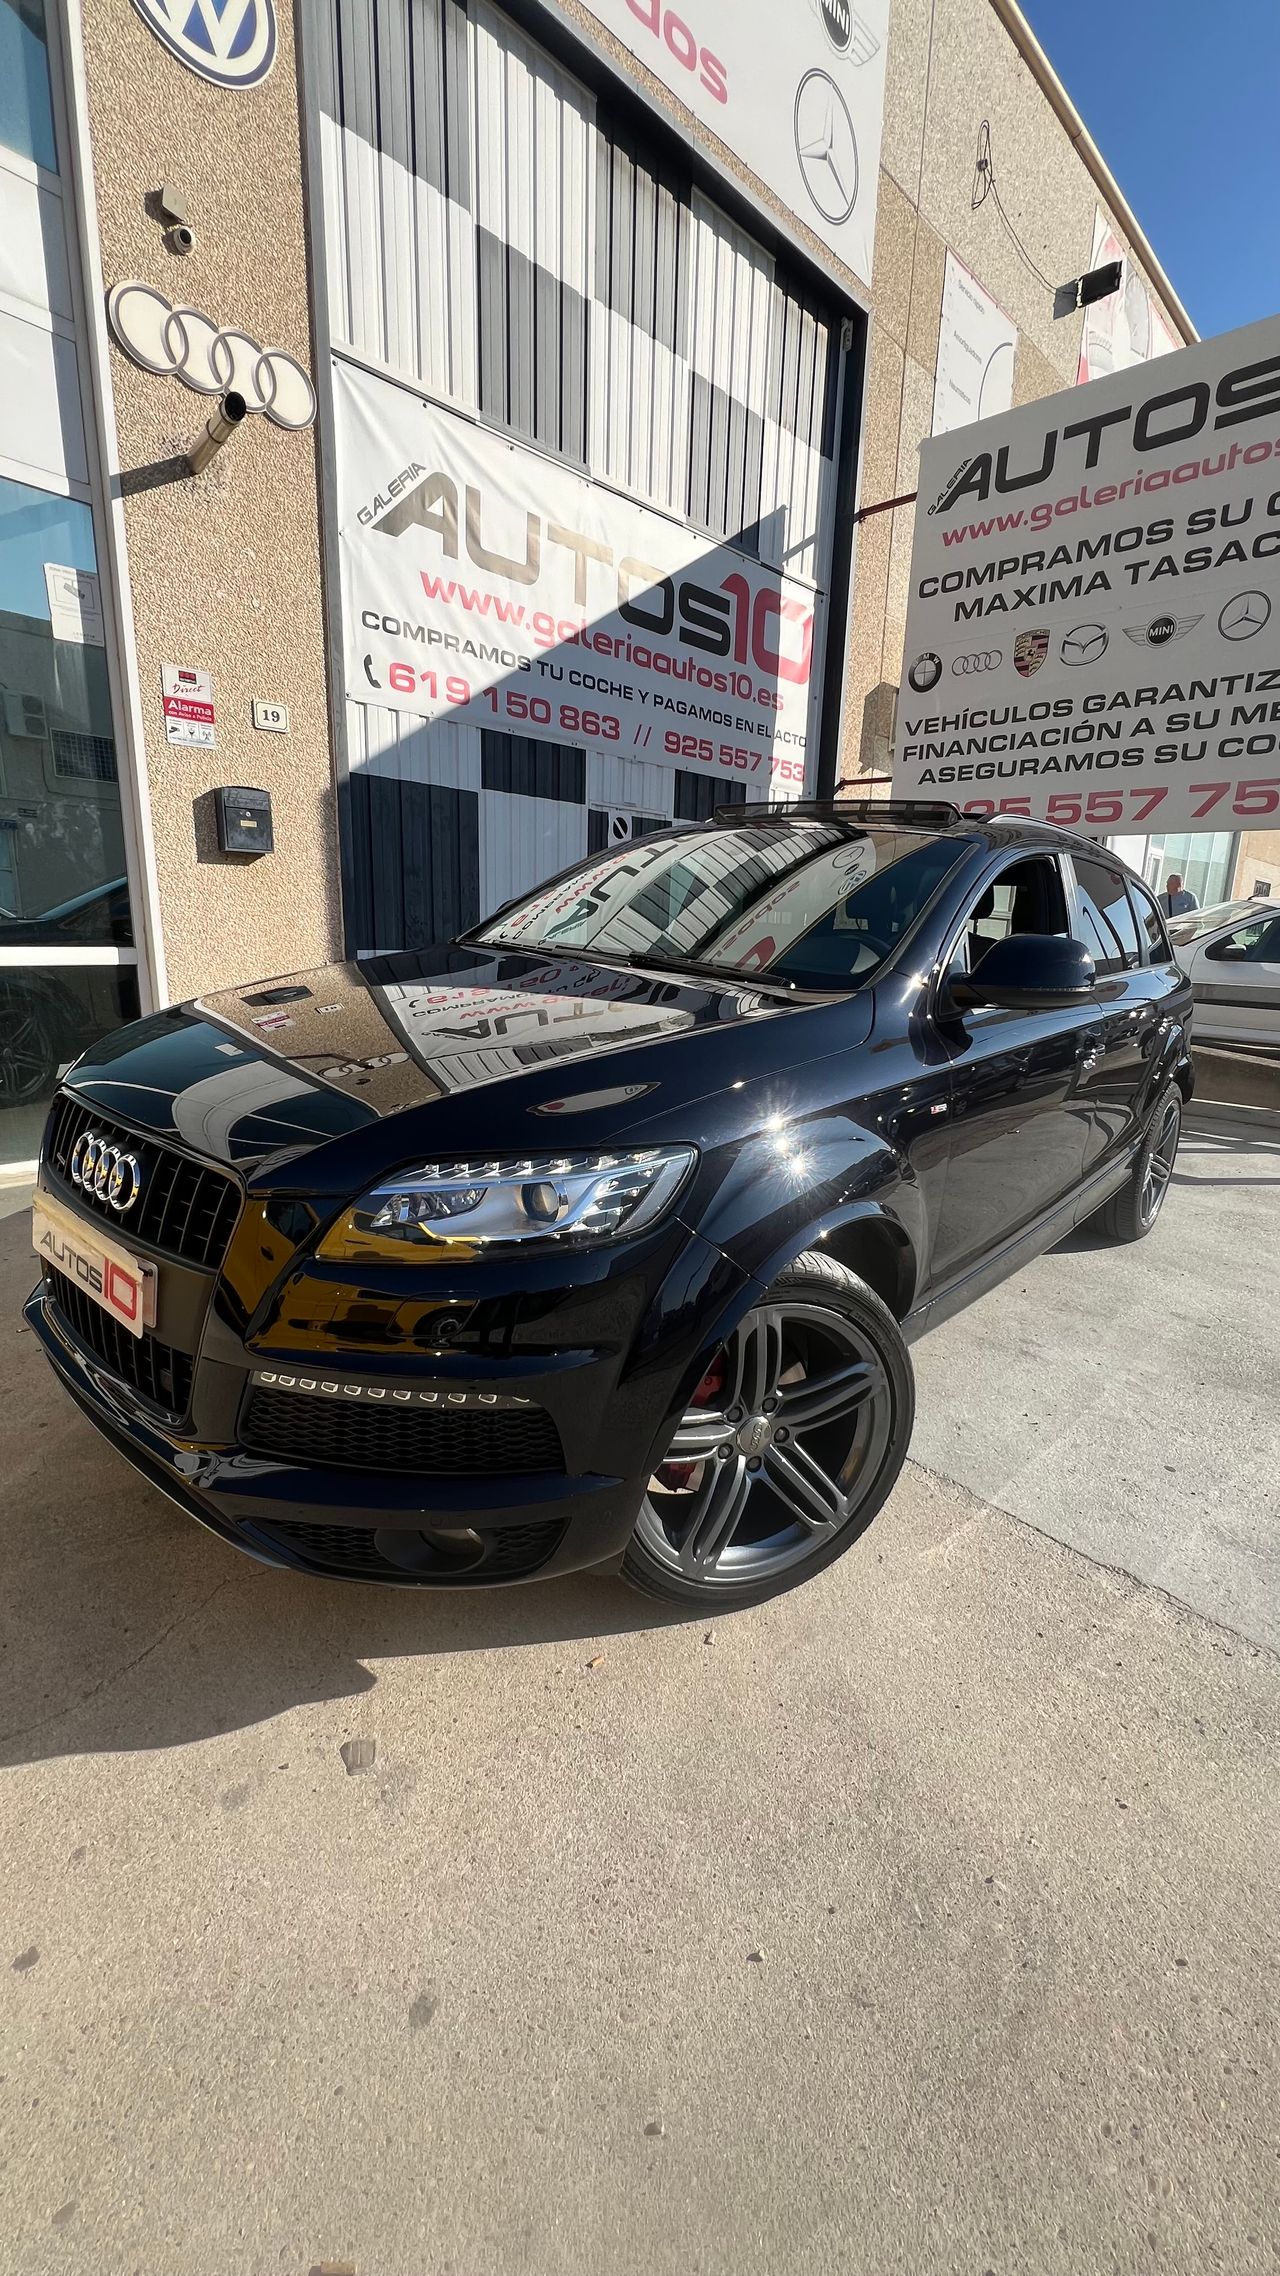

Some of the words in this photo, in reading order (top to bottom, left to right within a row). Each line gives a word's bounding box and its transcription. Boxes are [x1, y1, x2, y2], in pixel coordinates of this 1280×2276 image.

[356, 462, 427, 525] GALERIA
[927, 458, 973, 516] GALERIA
[942, 438, 1280, 547] www.galeriaauto
[371, 471, 813, 685] AUTOS10
[918, 518, 1174, 599] COMPRAMOS
[1186, 498, 1254, 536] SU
[954, 570, 1112, 622] MAXIMA
[1124, 530, 1280, 586] TASAC
[420, 570, 784, 711] www.galeriaautos10.es
[1149, 624, 1174, 637] MINI
[168, 699, 213, 717] Alarma
[361, 610, 531, 672] COMPRAMOS
[536, 660, 564, 681] TU
[568, 670, 633, 700] COCHE
[637, 688, 649, 705] Y
[653, 694, 732, 727] PAGAMOS
[735, 717, 754, 734] EN
[757, 723, 772, 739] EL
[774, 729, 807, 748] ACTO
[905, 698, 1073, 737] VEHÍCULOS
[1082, 669, 1280, 714] GARANTIZ
[262, 709, 281, 723] 19
[389, 662, 471, 706] 619
[482, 686, 551, 725] 150
[559, 704, 620, 741] 863
[664, 731, 713, 761] 925
[719, 744, 762, 772] 557
[768, 756, 806, 782] 753
[902, 720, 1122, 763] FINANCIACIÓN
[1130, 717, 1156, 738] A
[1165, 708, 1221, 733] SU
[917, 747, 1145, 786] ASEGURAMOS
[1154, 740, 1208, 765] SU
[1045, 786, 1169, 826] 557
[39, 1230, 138, 1321] AUTOS10
